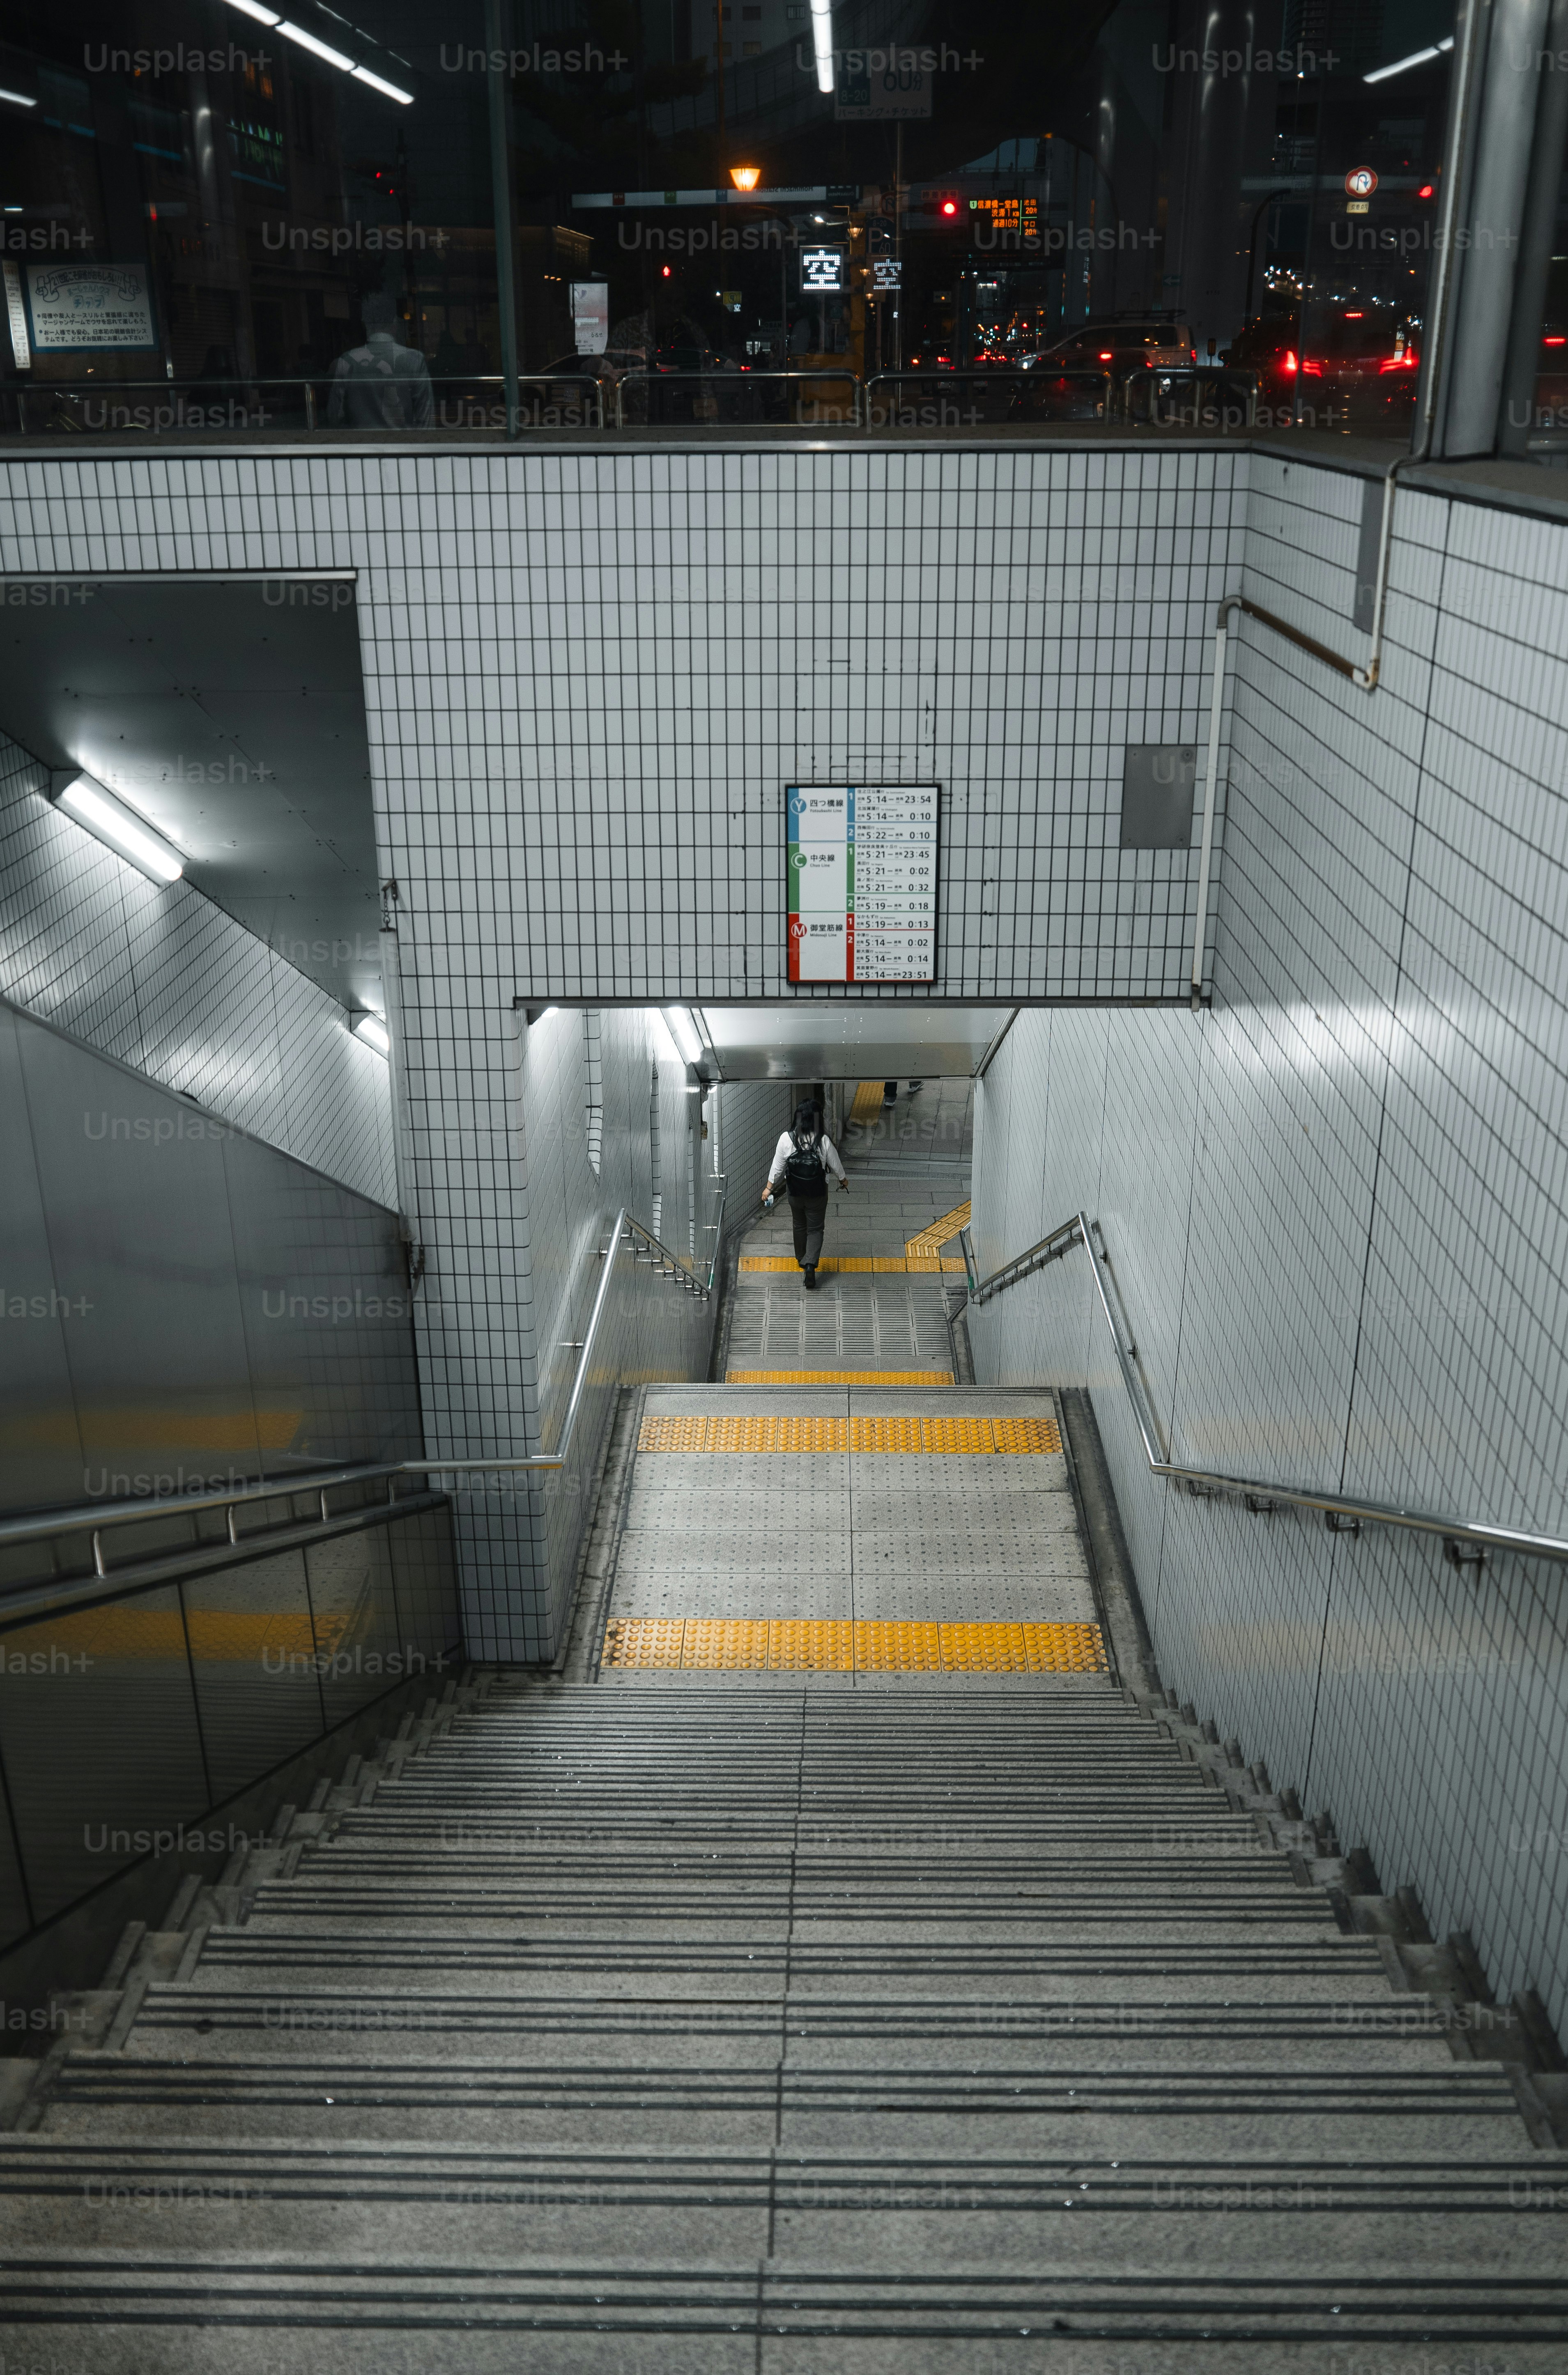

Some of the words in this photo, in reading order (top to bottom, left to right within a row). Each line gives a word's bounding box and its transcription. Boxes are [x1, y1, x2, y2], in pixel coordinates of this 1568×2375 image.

[841, 89, 867, 102] 8-20
[869, 228, 883, 253] P
[879, 242, 890, 254] 60
[803, 249, 841, 290] 空
[794, 800, 803, 812] Y
[794, 854, 803, 865] C
[793, 925, 805, 935] M
